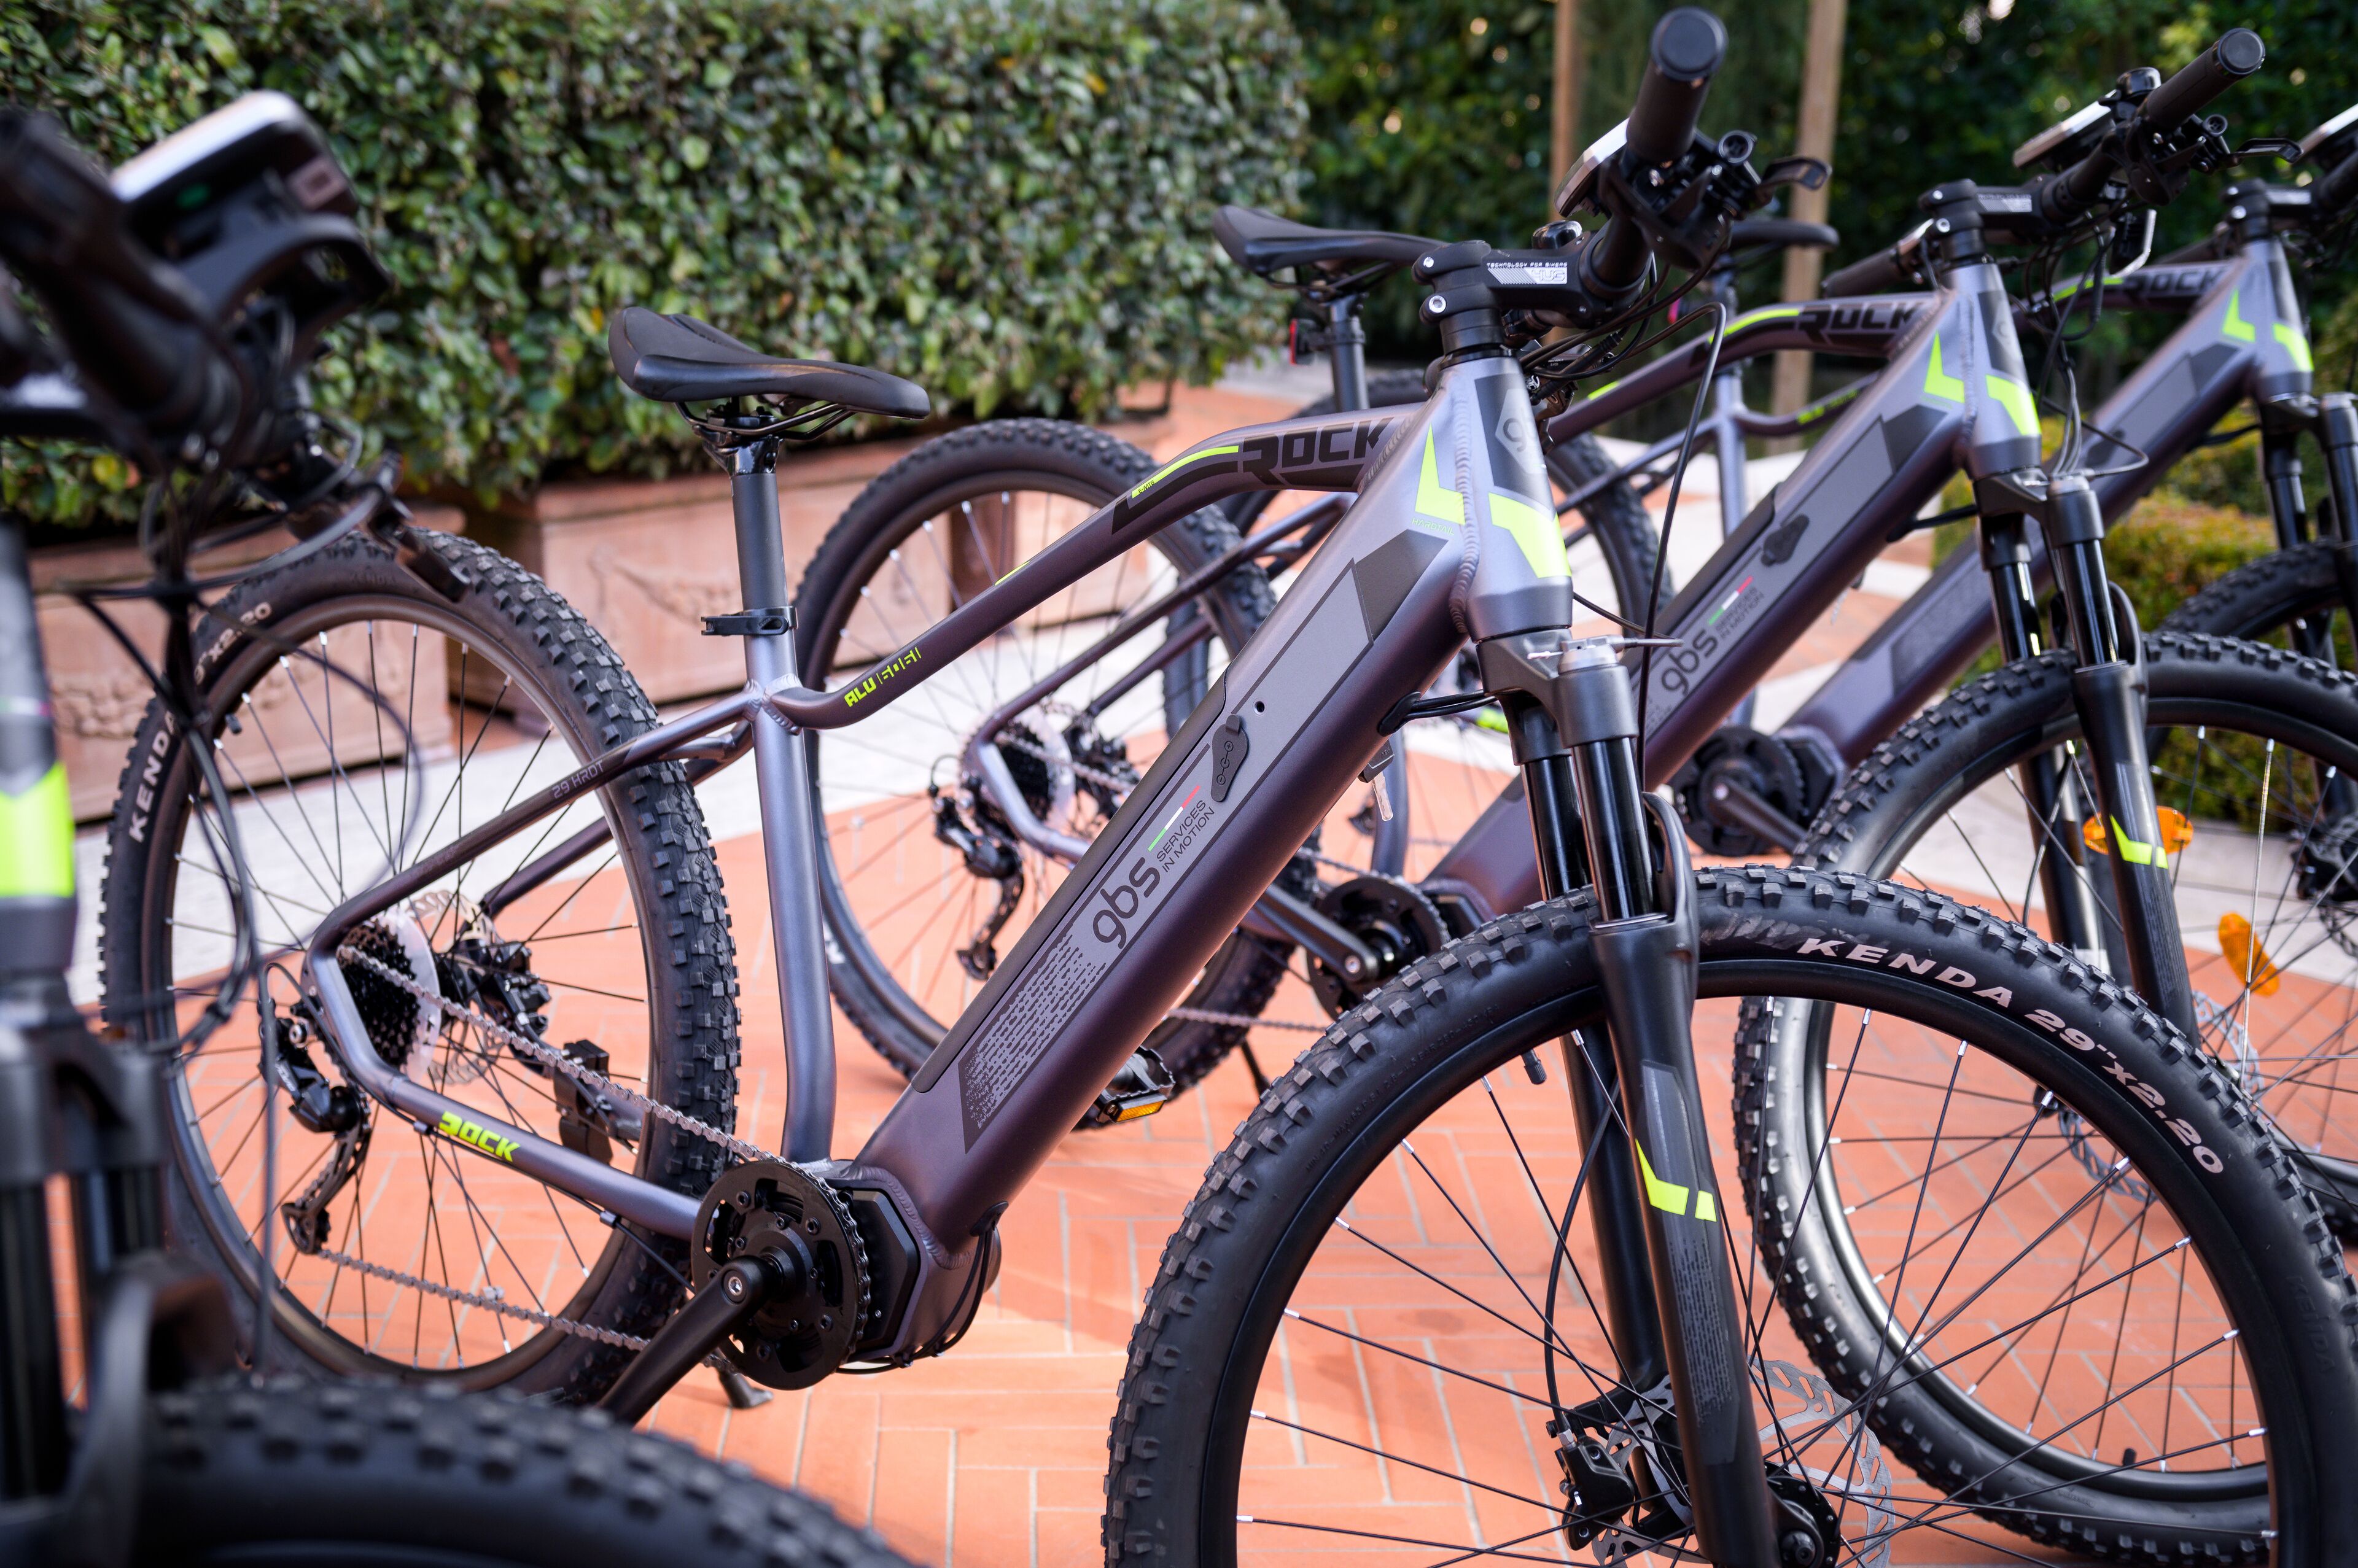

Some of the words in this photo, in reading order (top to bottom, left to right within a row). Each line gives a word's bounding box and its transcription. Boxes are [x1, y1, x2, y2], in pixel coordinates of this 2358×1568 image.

[1242, 417, 1395, 485] ROCK
[1138, 479, 1156, 494] E-MTB
[1412, 517, 1455, 535] HARDTAIL
[844, 677, 877, 707] ALU
[1661, 629, 1718, 696] gbs
[552, 780, 570, 799] 29
[571, 761, 604, 788] HRDT
[1156, 800, 1206, 862] SERVICES
[1162, 860, 1175, 872] IN
[1174, 806, 1215, 859] MOTION
[1092, 856, 1161, 949] gbs
[1797, 937, 2013, 1008] KENDA
